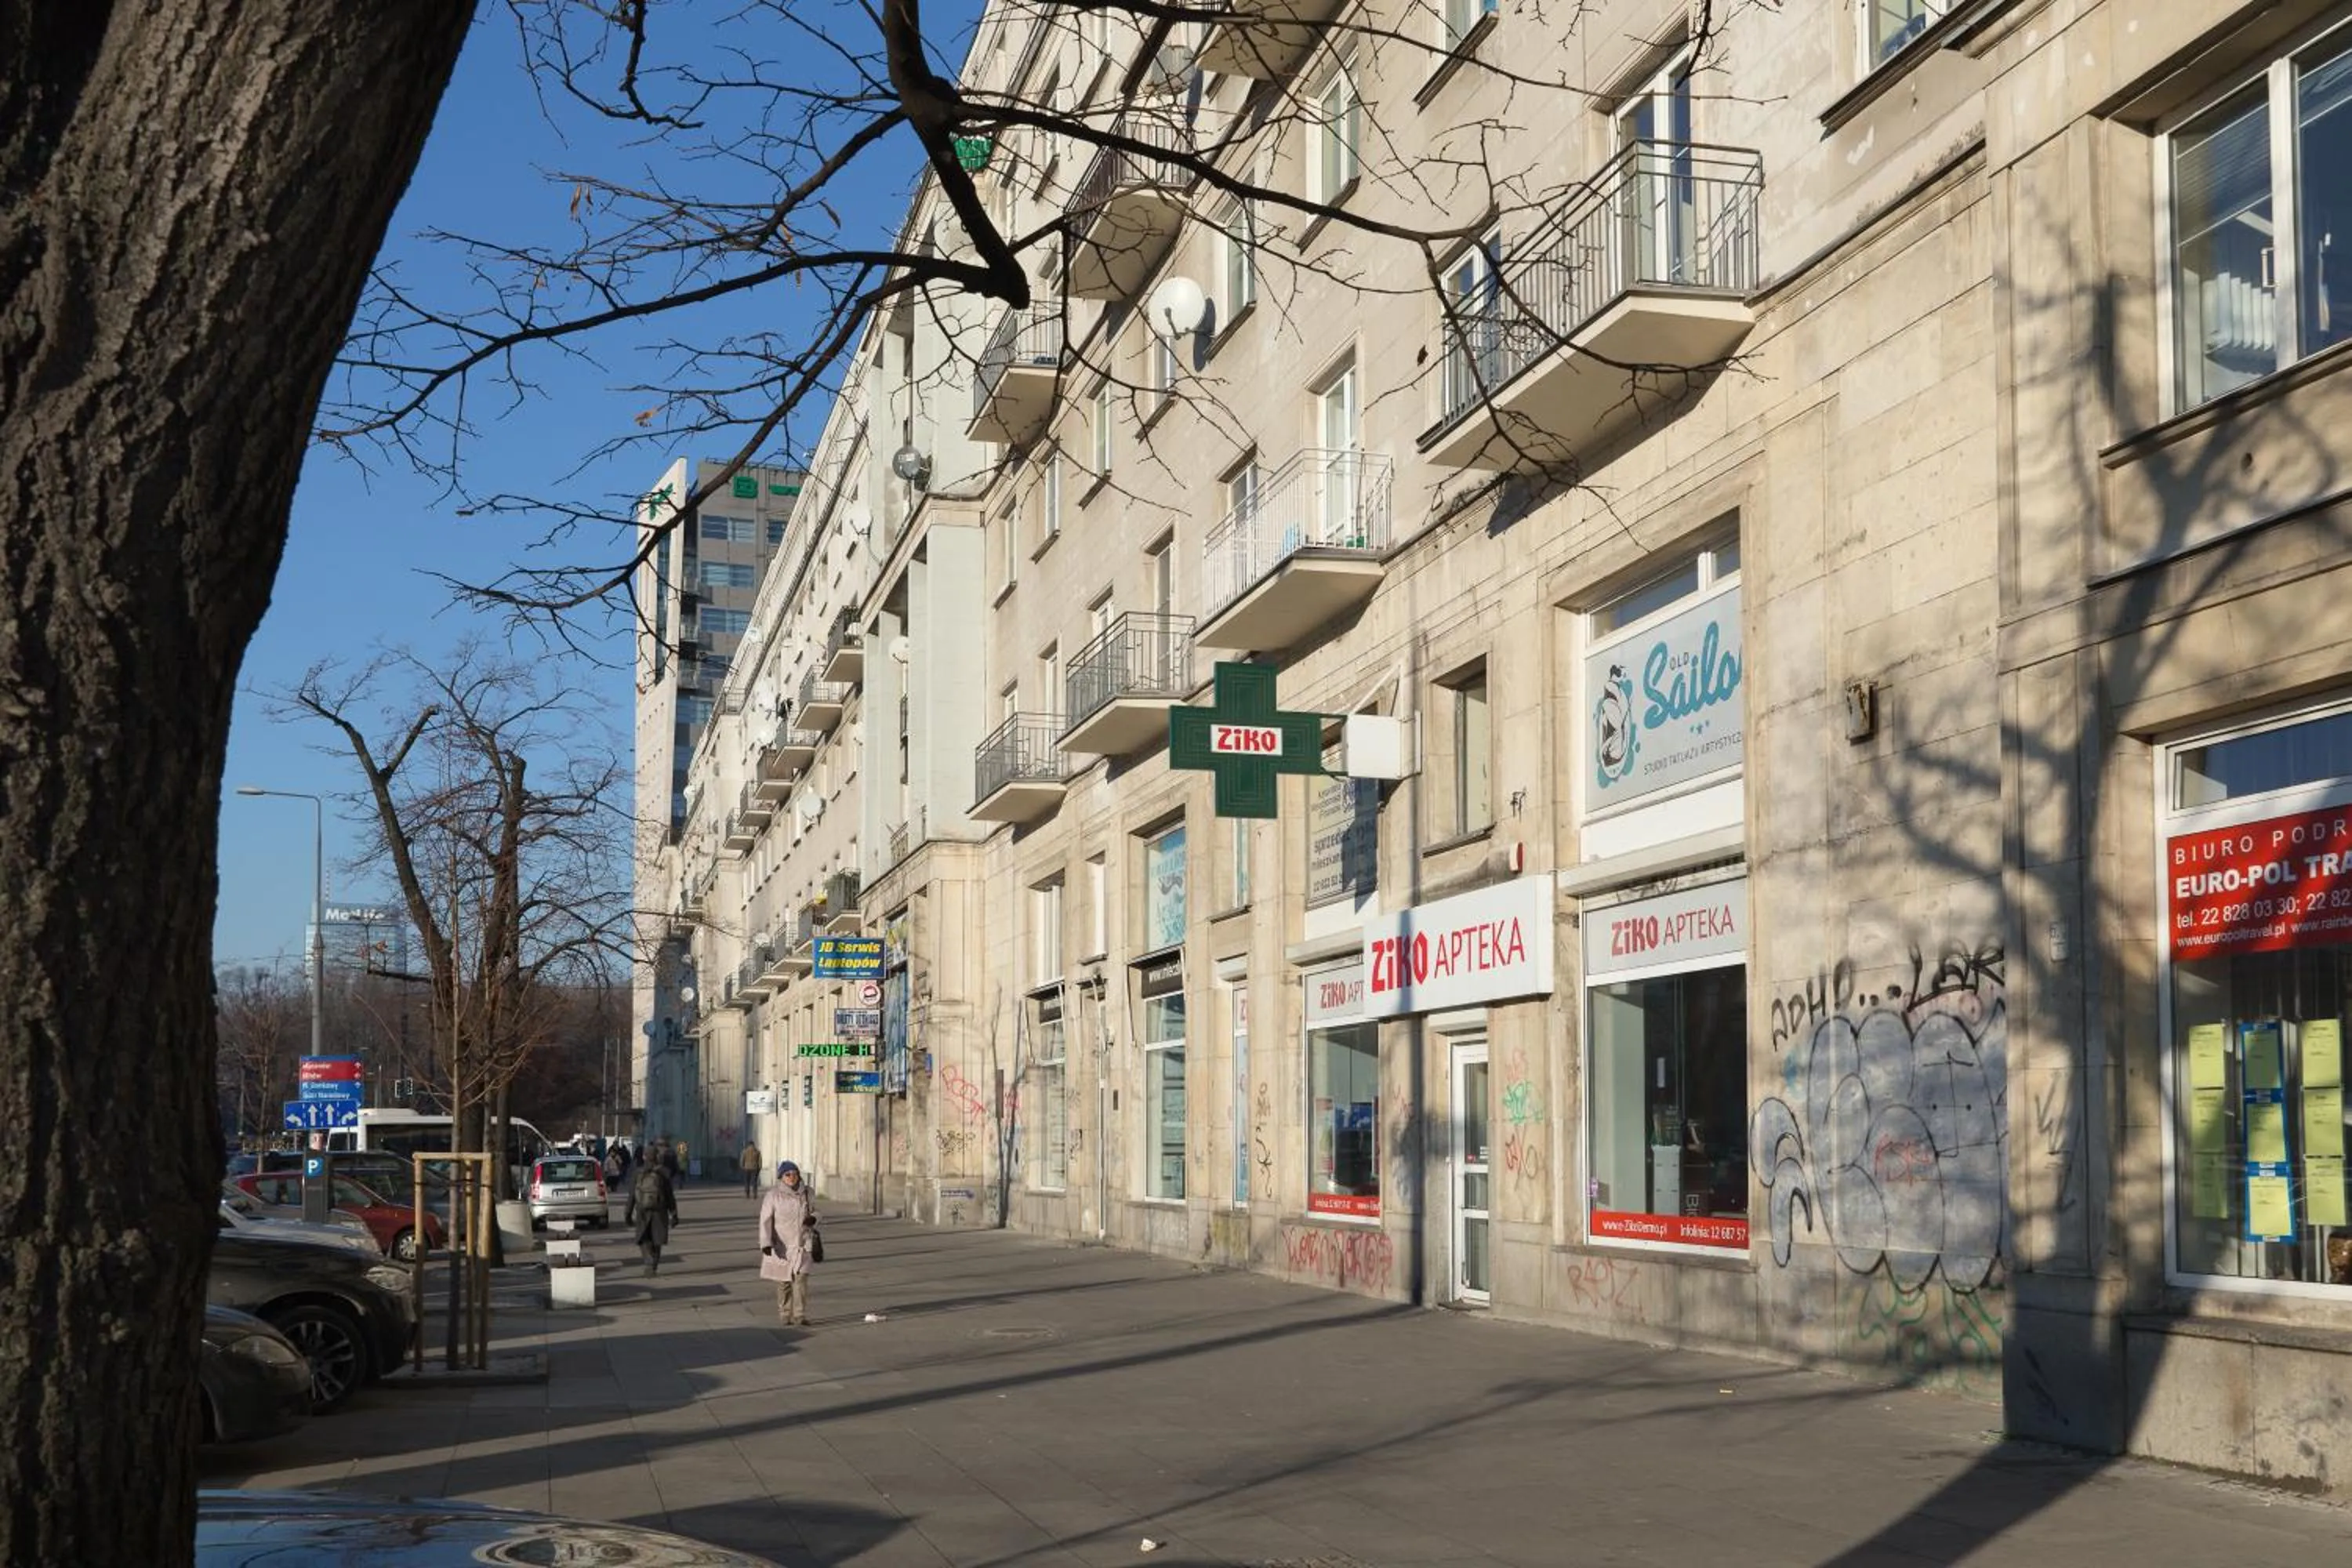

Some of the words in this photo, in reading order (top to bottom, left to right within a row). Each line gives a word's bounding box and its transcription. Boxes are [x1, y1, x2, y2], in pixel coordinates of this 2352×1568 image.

[1643, 621, 1743, 729] Sailo
[1670, 652, 1690, 671] OLD
[2175, 835, 2254, 865] BIURO
[2273, 818, 2347, 848] PODR
[2176, 860, 2297, 899] EURO-POL
[1663, 903, 1735, 946] APTEKA
[2176, 910, 2197, 929] tel.
[2201, 906, 2220, 926] 22
[2223, 902, 2249, 923] 828
[2253, 899, 2273, 918] 03
[2277, 895, 2301, 916] 30;
[2306, 891, 2326, 912] 22
[1434, 916, 1526, 979] APTEKA
[308, 1160, 319, 1174] P
